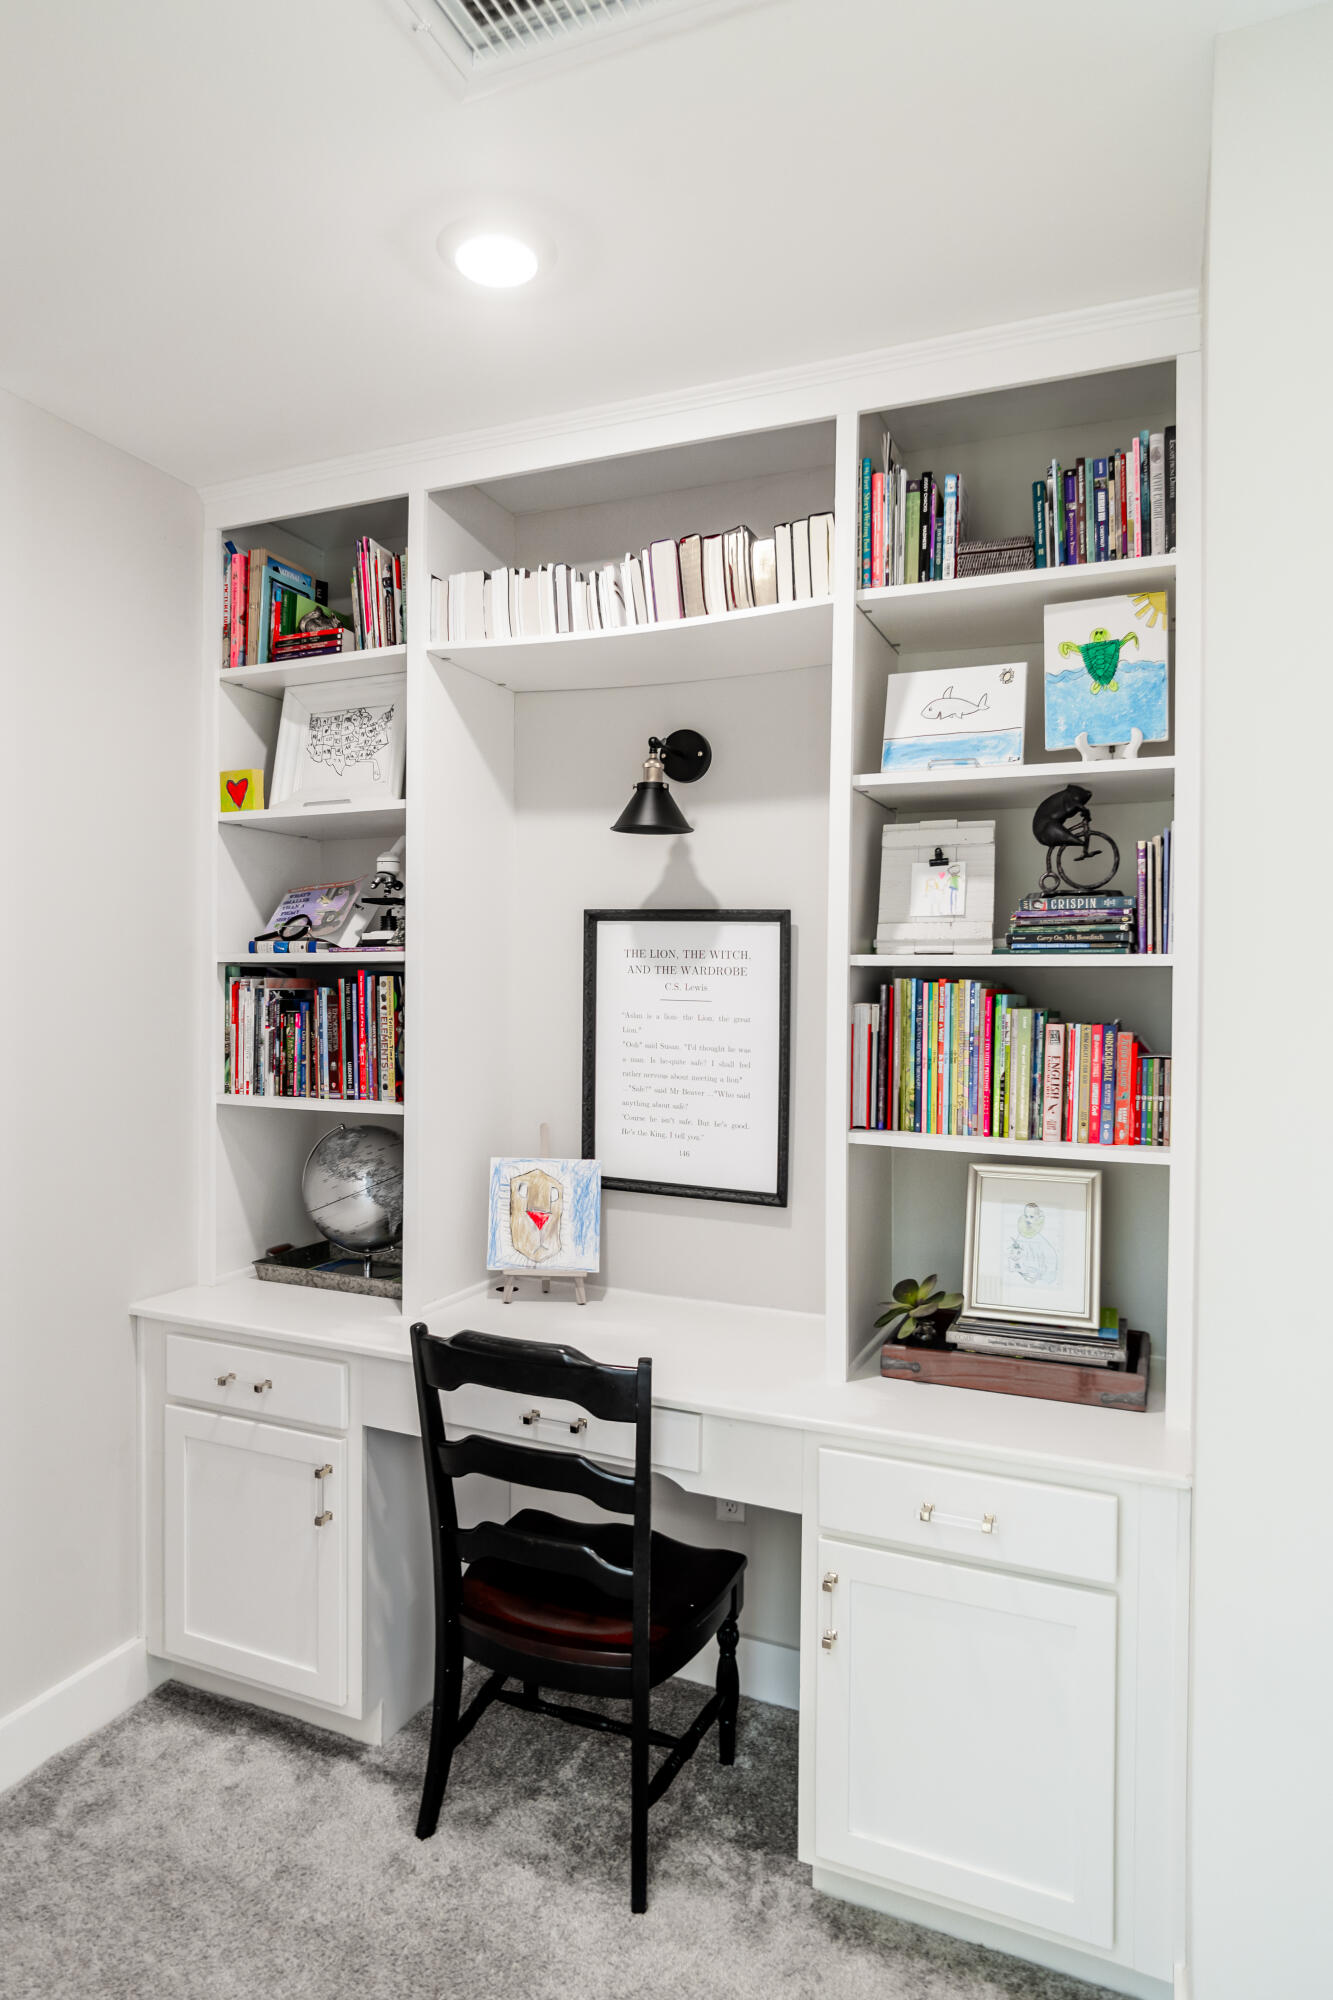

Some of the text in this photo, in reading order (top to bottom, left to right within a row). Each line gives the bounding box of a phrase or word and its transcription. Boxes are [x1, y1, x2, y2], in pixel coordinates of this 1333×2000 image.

[863, 492, 871, 510] Story
[1051, 898, 1096, 909] CRISPIN
[624, 949, 646, 959] THE
[650, 950, 679, 959] LION,
[683, 950, 706, 959] THE
[627, 965, 748, 976] AND THE WARDROBE
[665, 983, 708, 991] C.S. Lewis
[699, 1044, 725, 1053] thought
[1104, 1033, 1114, 1081] INDESCRIBABLE
[719, 1060, 734, 1068] shall
[692, 1074, 717, 1083] meeting
[1051, 1056, 1061, 1099] ENGLISH
[682, 1089, 704, 1097] Beaver
[622, 1100, 650, 1108] anything
